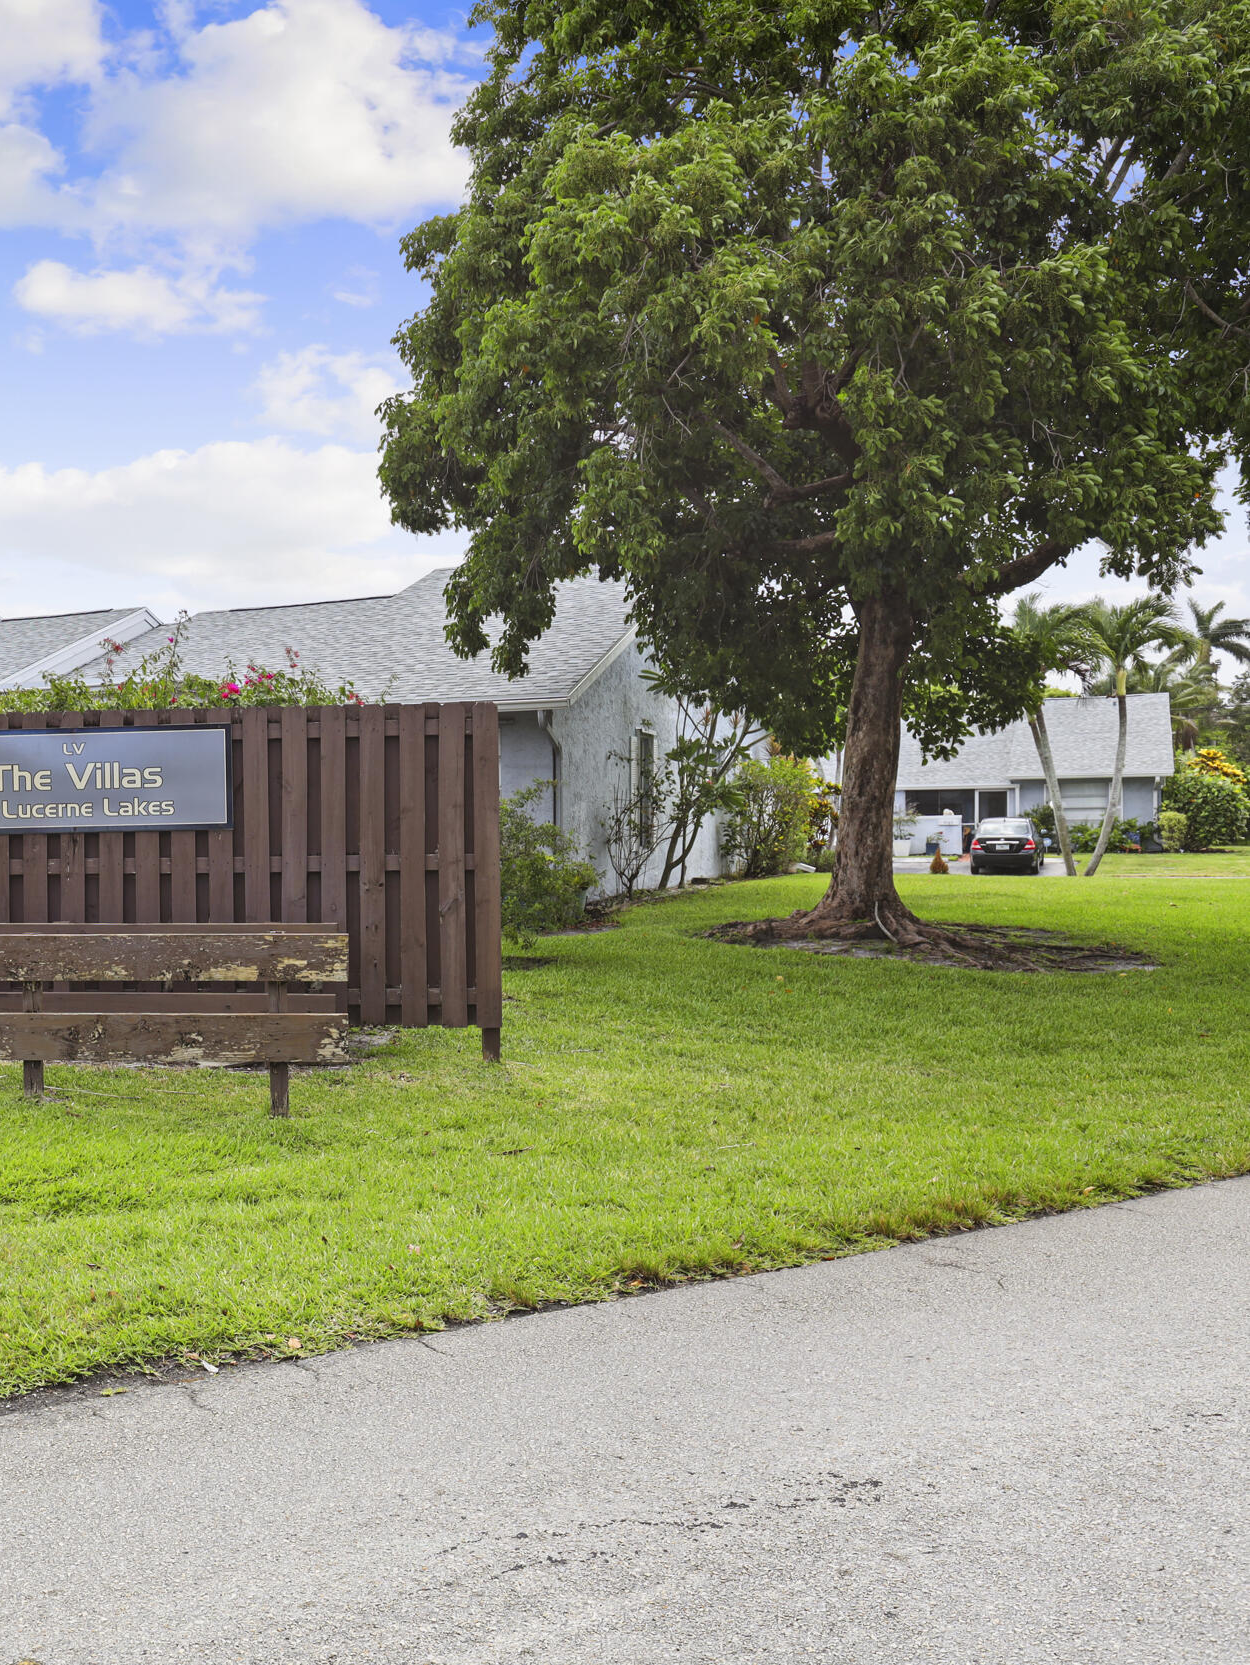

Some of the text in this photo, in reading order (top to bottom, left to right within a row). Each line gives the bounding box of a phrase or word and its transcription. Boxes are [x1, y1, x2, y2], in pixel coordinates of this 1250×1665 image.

[63, 742, 85, 755] LV
[65, 762, 163, 790] Villas
[1, 800, 93, 819] Lucerne
[103, 797, 175, 817] Lakes
